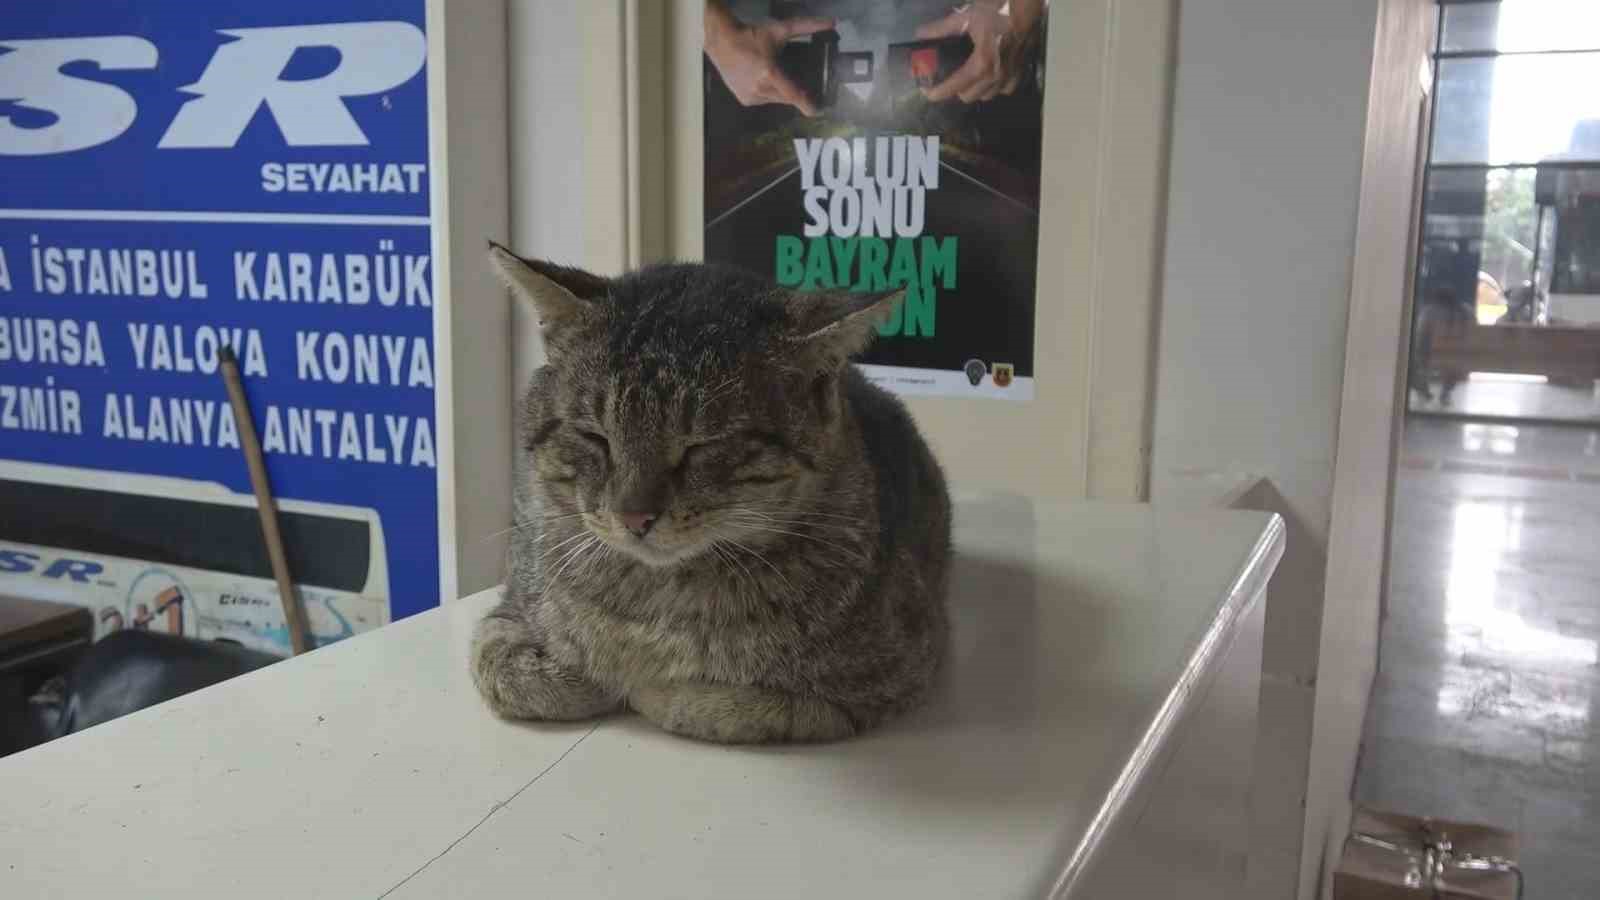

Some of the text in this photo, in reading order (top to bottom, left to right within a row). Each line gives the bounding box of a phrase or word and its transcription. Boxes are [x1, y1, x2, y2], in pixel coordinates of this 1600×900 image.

[261, 163, 426, 193] SEYAHAT
[794, 136, 939, 189] YOLUN
[804, 185, 925, 237] SONU
[31, 234, 208, 299] İSTANBUL
[234, 240, 432, 306] KARABÜK
[776, 236, 957, 290] BAYRAM
[0, 317, 434, 388] BURSA YALOVA KONYA
[103, 394, 240, 449] ALANYA
[263, 405, 437, 468] ANTALYA
